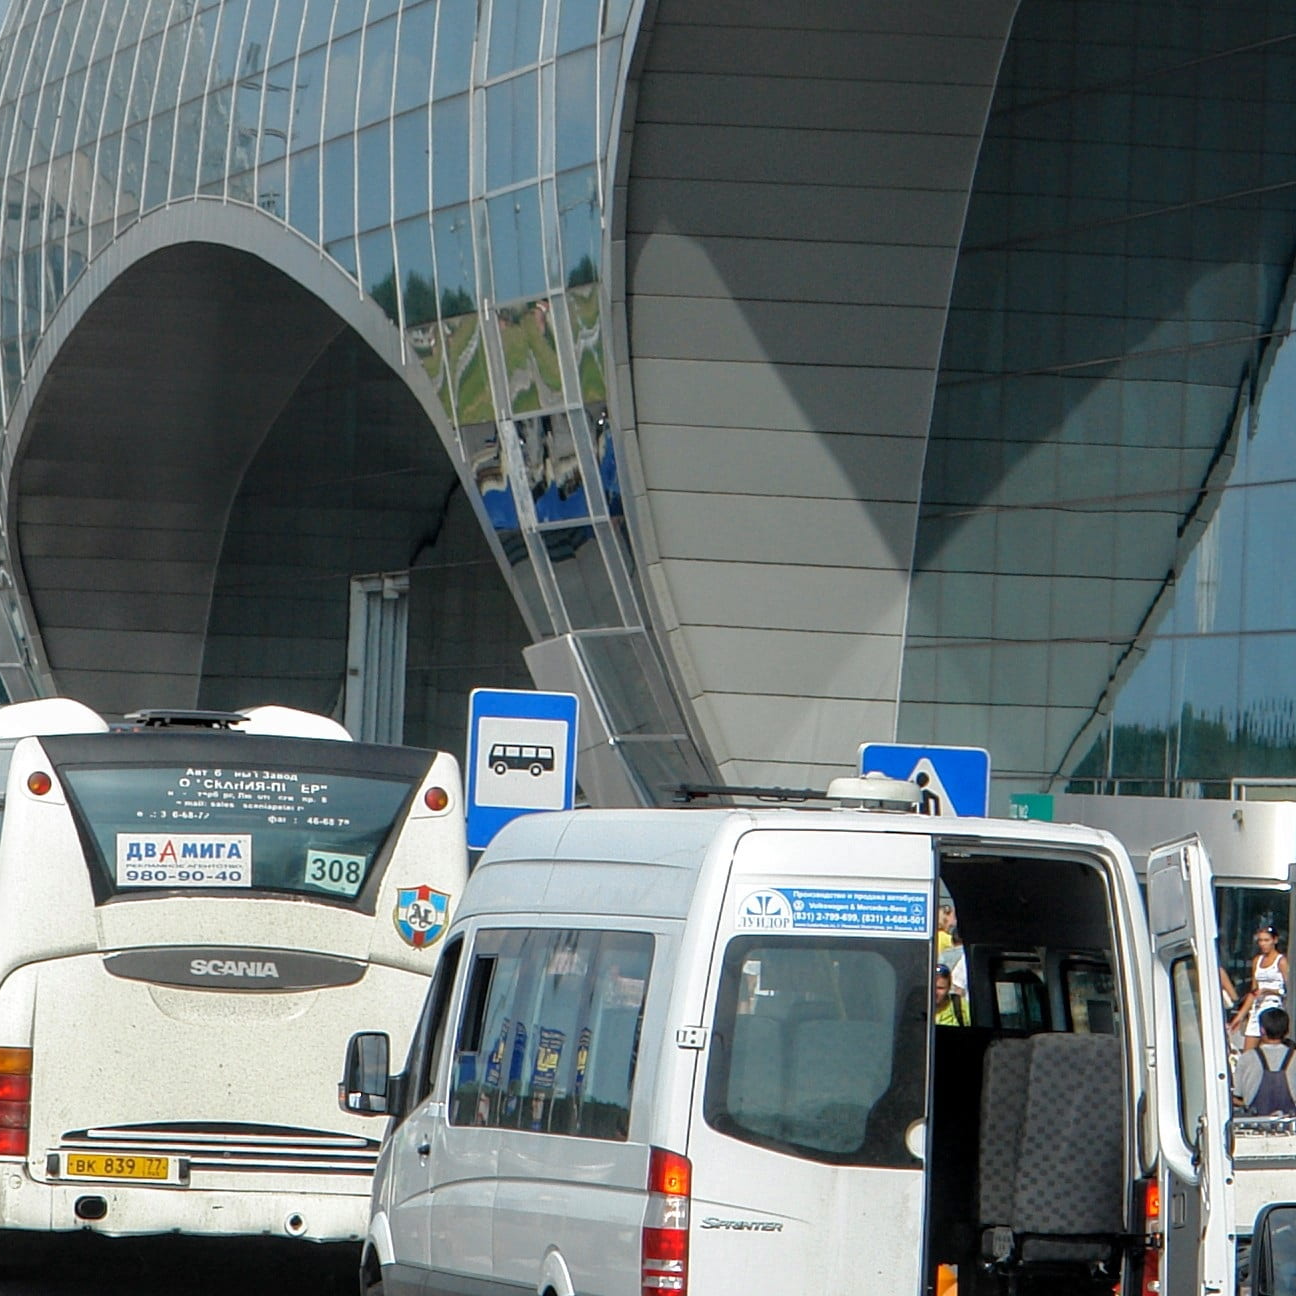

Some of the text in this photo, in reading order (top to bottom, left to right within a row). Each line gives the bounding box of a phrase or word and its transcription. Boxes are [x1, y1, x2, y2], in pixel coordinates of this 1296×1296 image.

[181, 842, 243, 860] МИГА
[126, 870, 243, 882] 980-90-40
[311, 857, 360, 884] 308
[738, 916, 790, 928] ЛУИДОР
[793, 912, 815, 922] (831)
[862, 913, 884, 924] (831)
[190, 959, 280, 978] SCANIA
[76, 1158, 162, 1174] ВК 839 77
